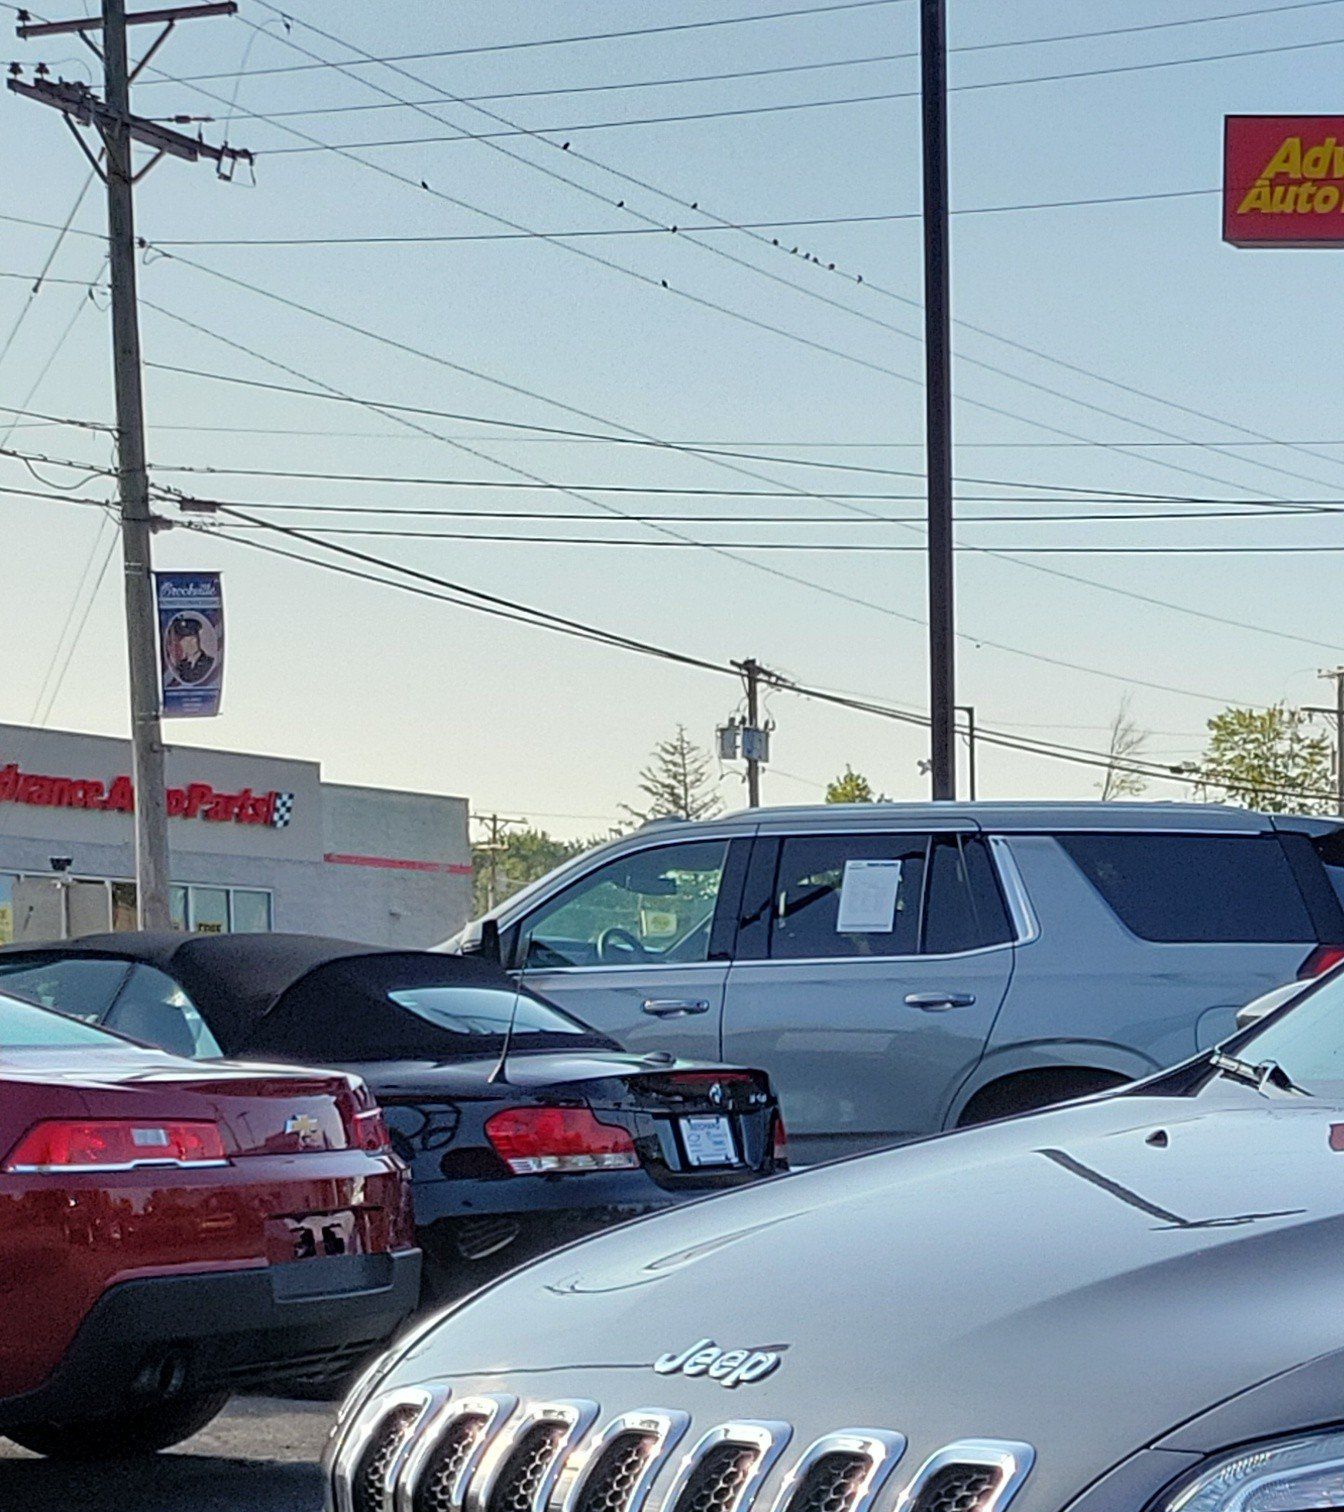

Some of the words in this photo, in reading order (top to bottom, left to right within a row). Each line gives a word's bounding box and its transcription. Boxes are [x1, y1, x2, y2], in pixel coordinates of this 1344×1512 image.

[1237, 178, 1340, 215] Auto
[0, 763, 105, 809] dvance
[96, 775, 187, 818] Ao
[183, 782, 269, 826] Parts
[653, 1338, 780, 1388] Jeep
